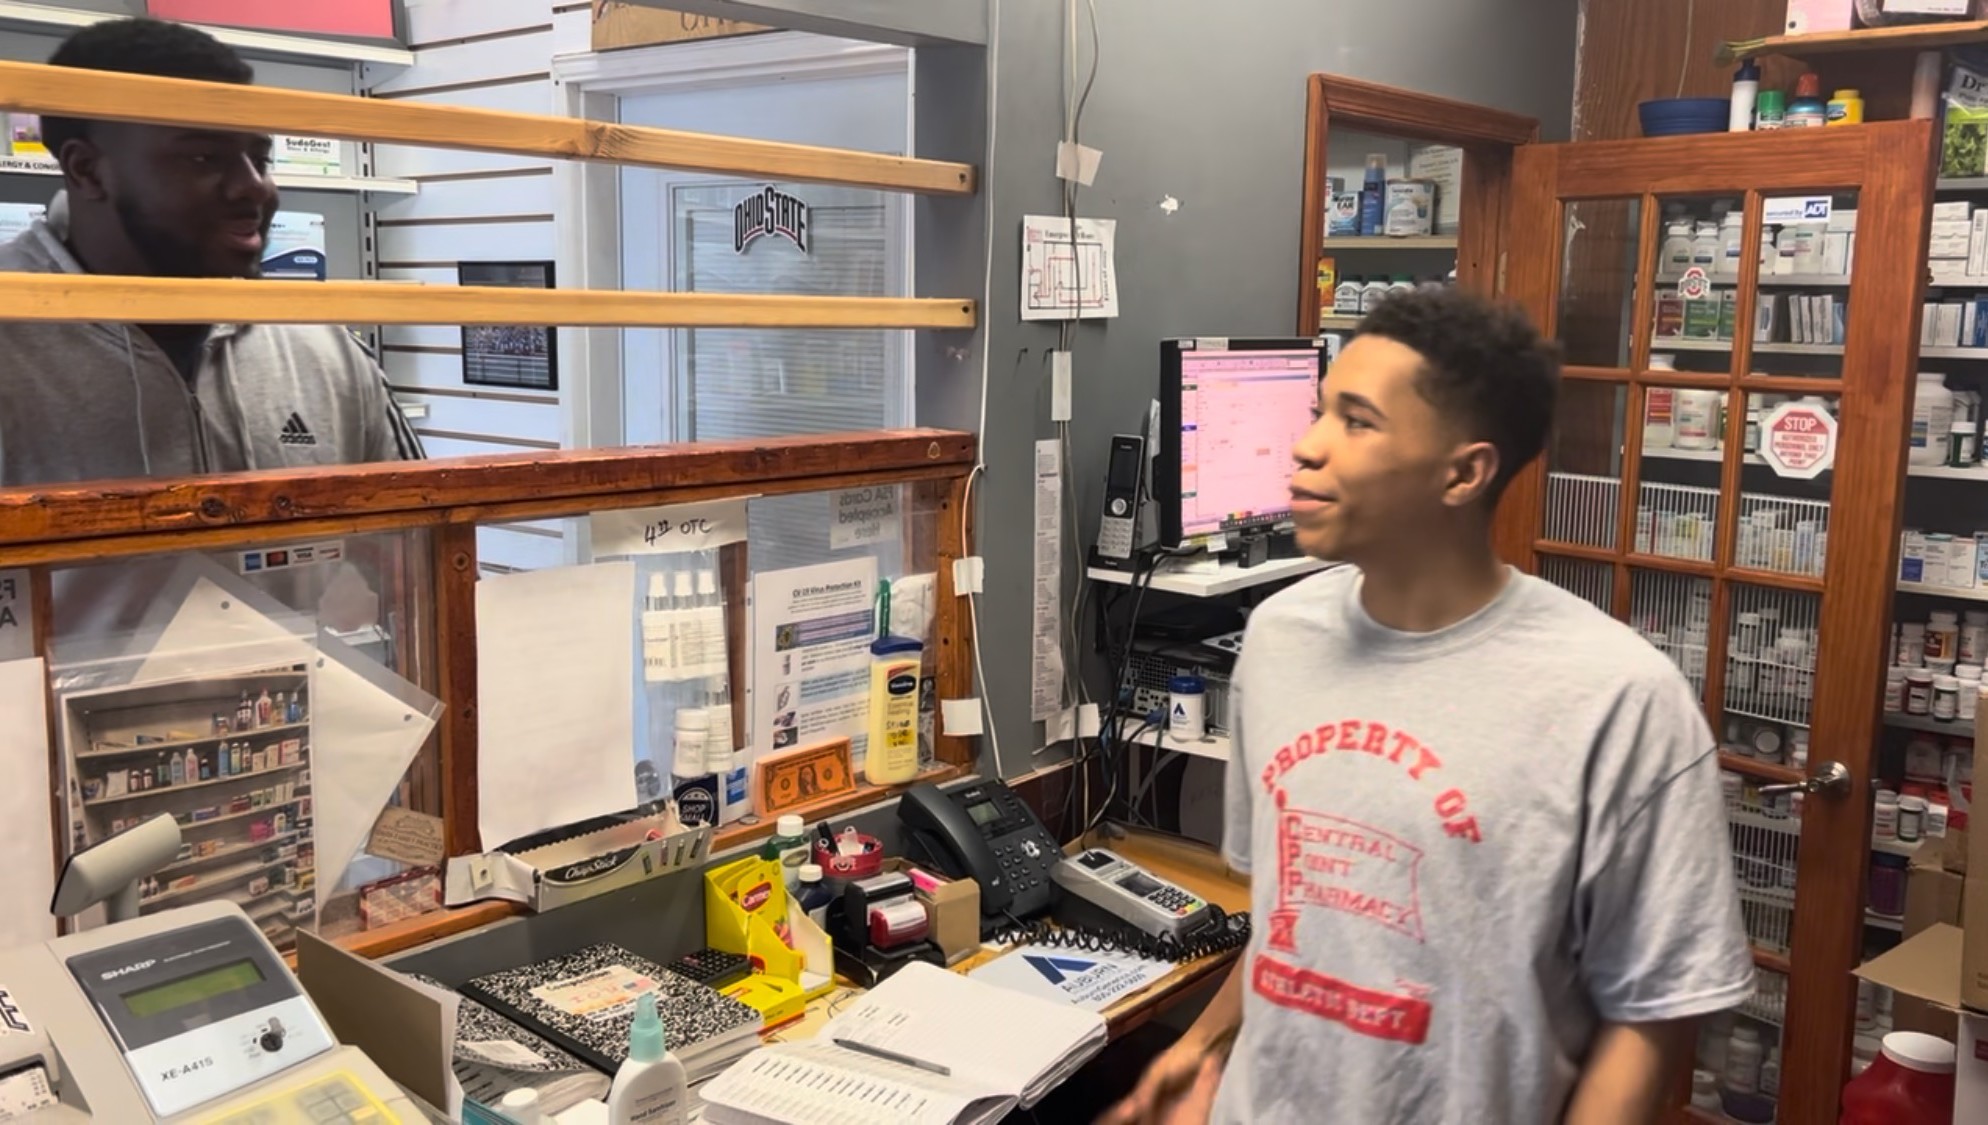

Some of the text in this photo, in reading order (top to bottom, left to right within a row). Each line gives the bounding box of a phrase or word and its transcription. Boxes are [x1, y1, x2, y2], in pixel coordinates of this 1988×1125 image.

[735, 186, 805, 252] OHIO STATE
[1806, 203, 1827, 215] ADT
[1784, 417, 1818, 432] STOP
[680, 519, 713, 535] OTC
[1262, 719, 1483, 844] PROPERTY OF
[1287, 815, 1397, 862] CENTRAL
[101, 959, 156, 980] SHARP
